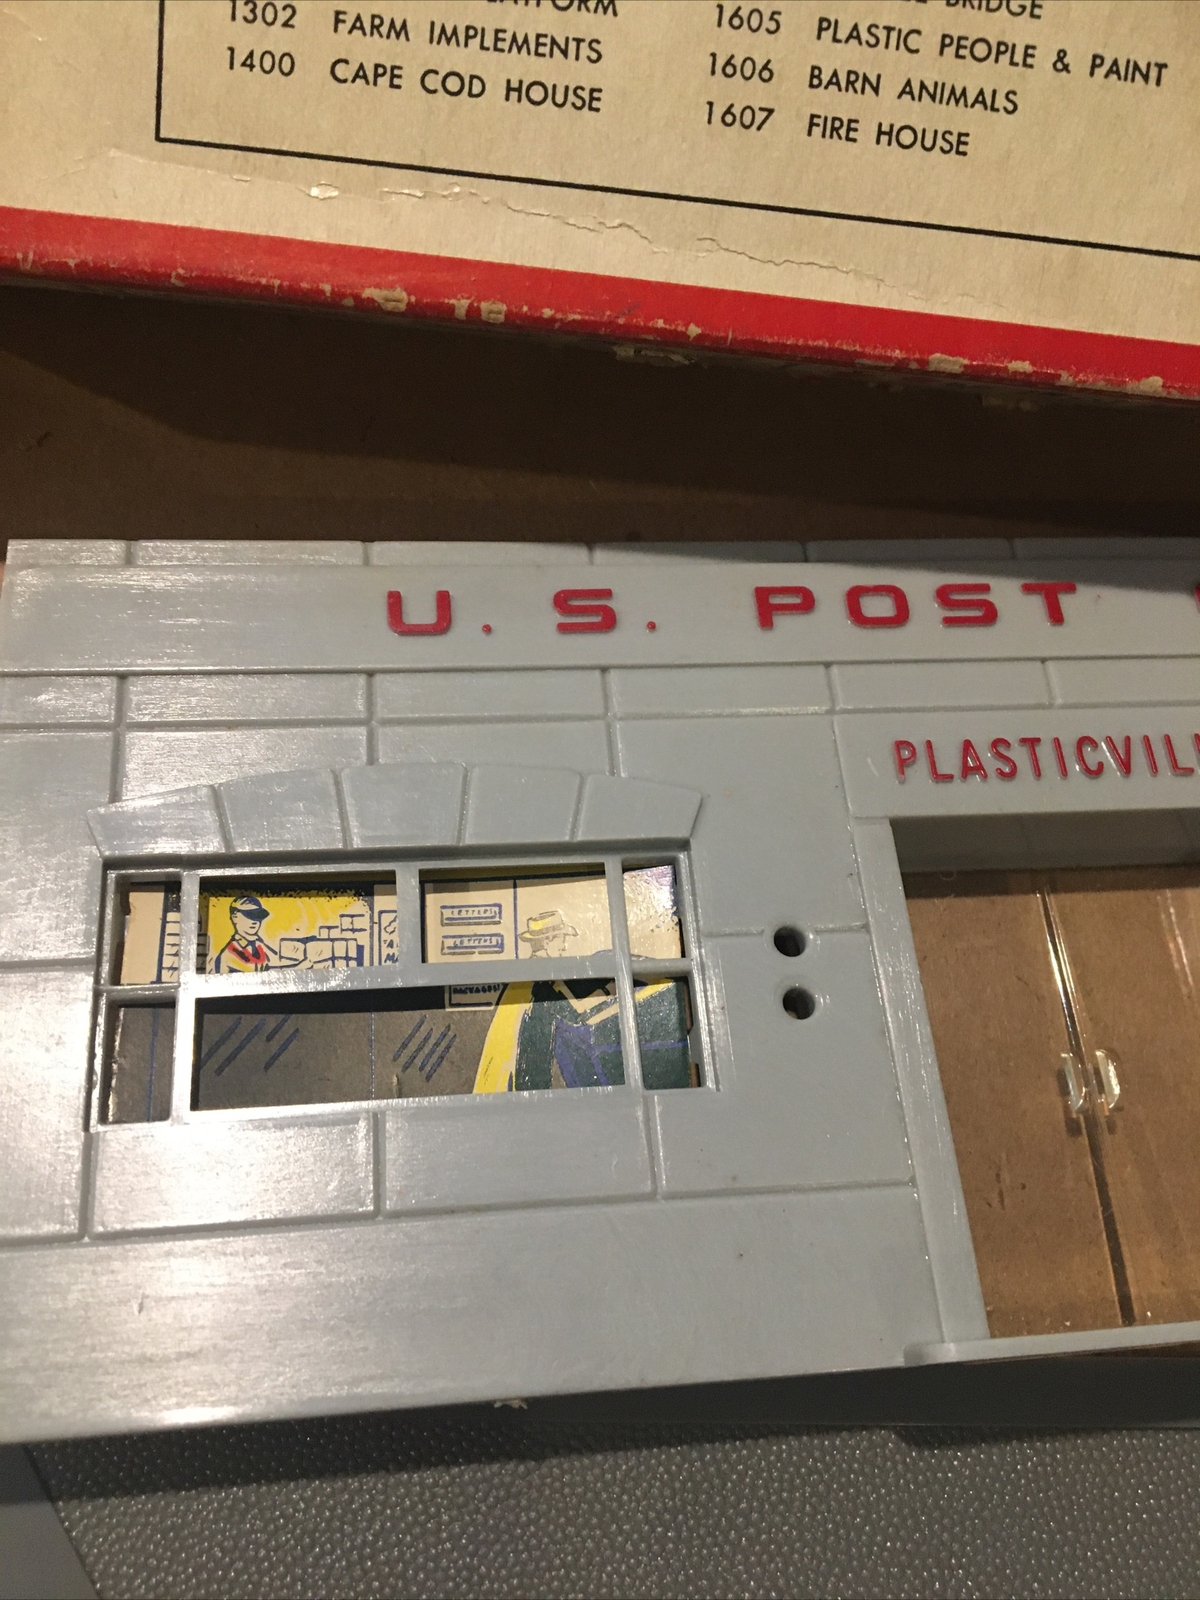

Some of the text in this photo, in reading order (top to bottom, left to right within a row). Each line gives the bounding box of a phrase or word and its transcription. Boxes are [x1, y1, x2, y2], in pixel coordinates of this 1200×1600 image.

[229, 0, 603, 64] 1302 FARM IMPLEMENTS
[716, 3, 1169, 87] 1605 PLASTIC PEOPLE & PAINT
[227, 46, 603, 113] 1400 CAPE COD HOUSE
[709, 52, 1018, 115] 1606 BARN ANIMALS
[706, 100, 970, 157] 1607 FIRE HOUSE
[753, 581, 1077, 630] POST
[893, 732, 1200, 782] PLASTICVIL
